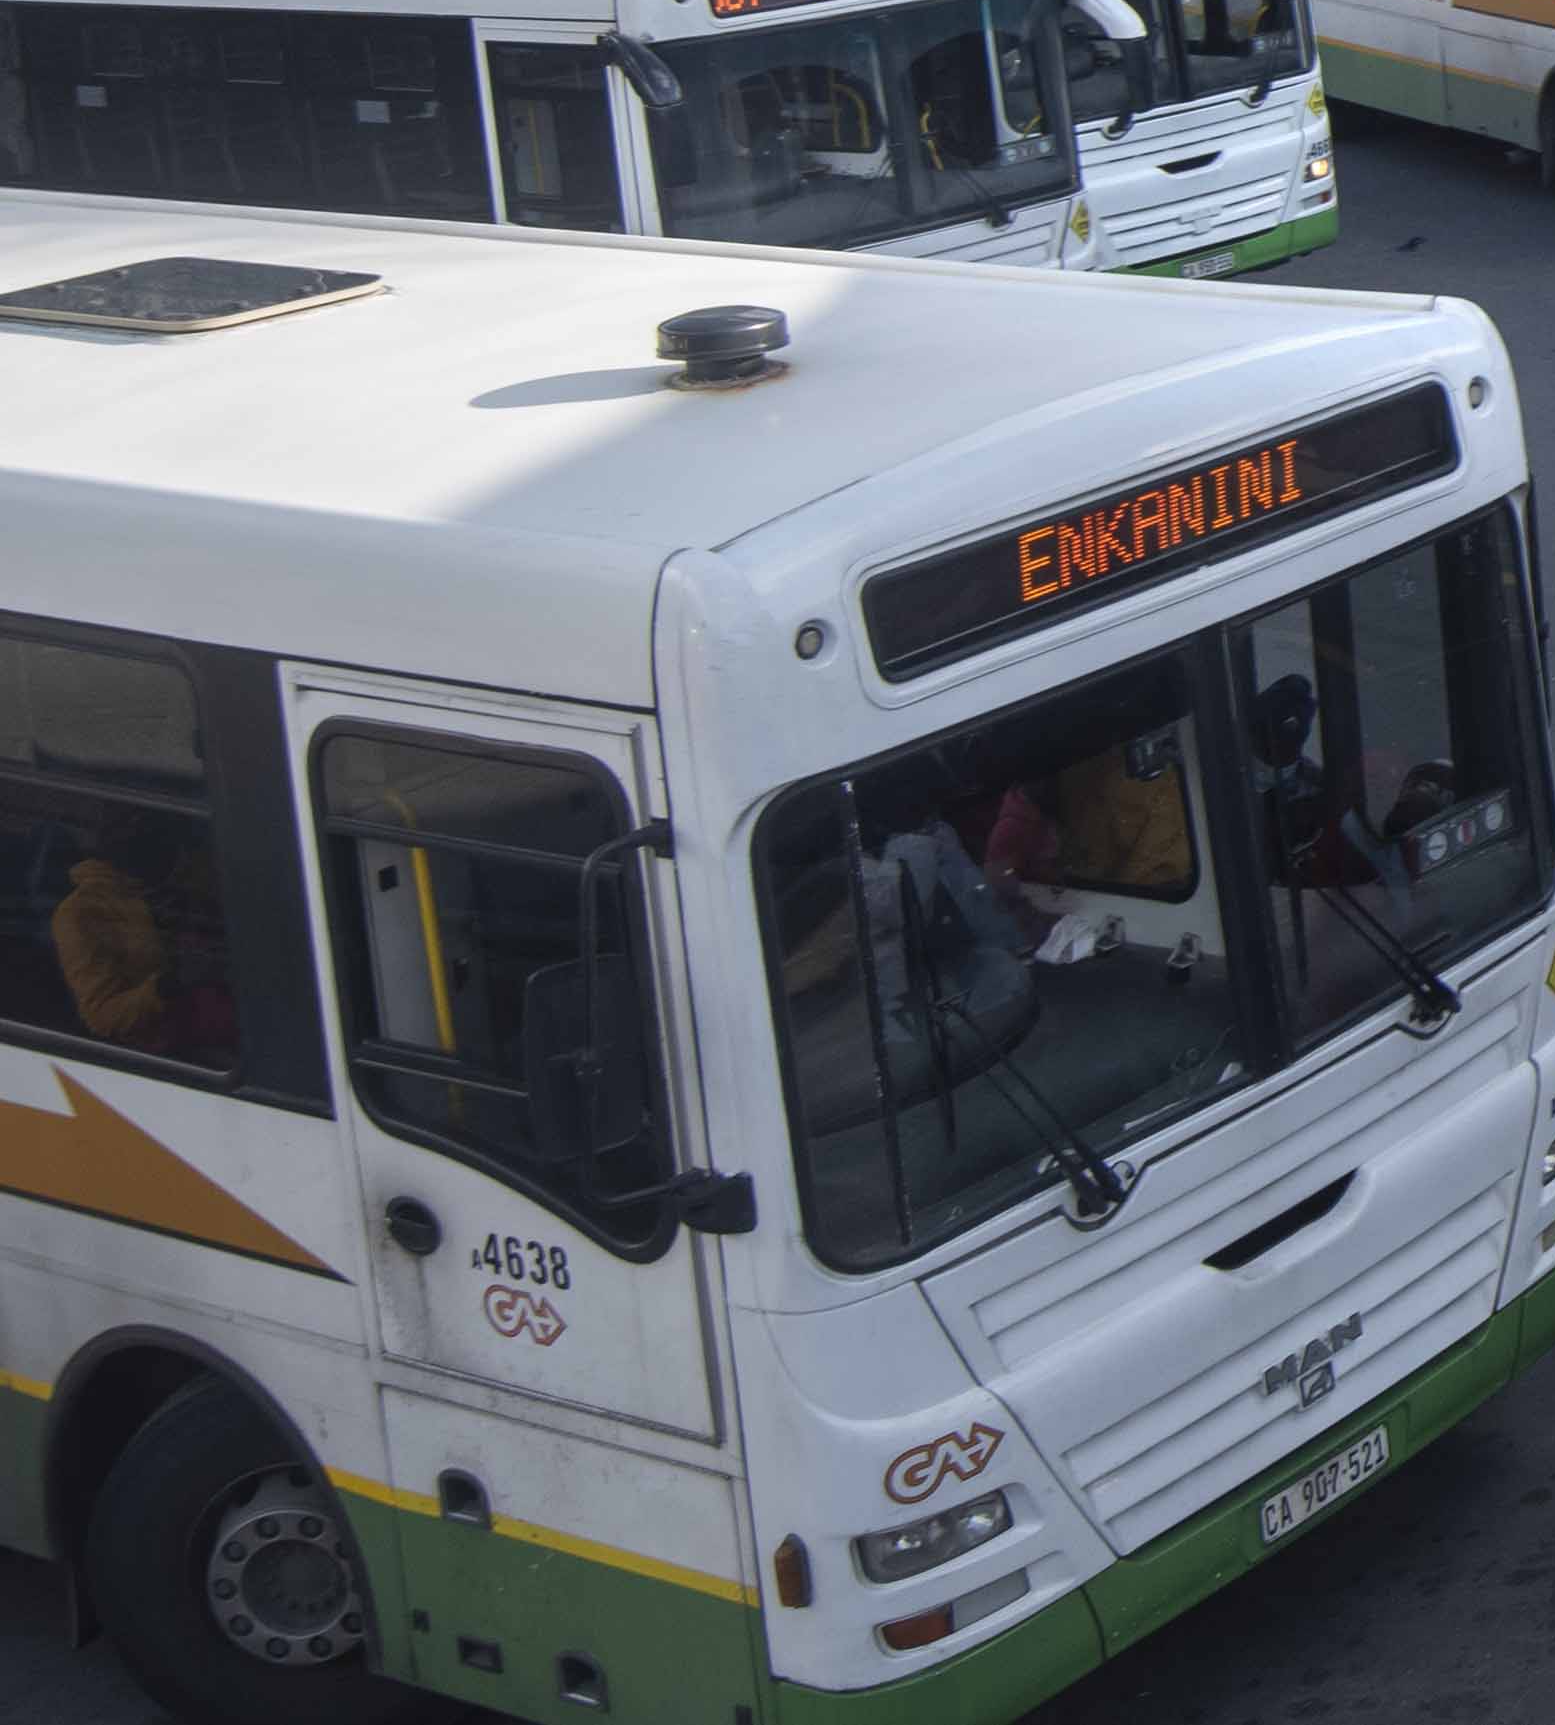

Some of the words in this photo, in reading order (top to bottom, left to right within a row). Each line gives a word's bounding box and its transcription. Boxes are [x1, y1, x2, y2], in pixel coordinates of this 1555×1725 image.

[1016, 439, 1302, 603] ENKANINI
[1262, 1311, 1364, 1397] MAN
[1263, 1498, 1294, 1537] CA
[1301, 1433, 1387, 1516] 907-521
